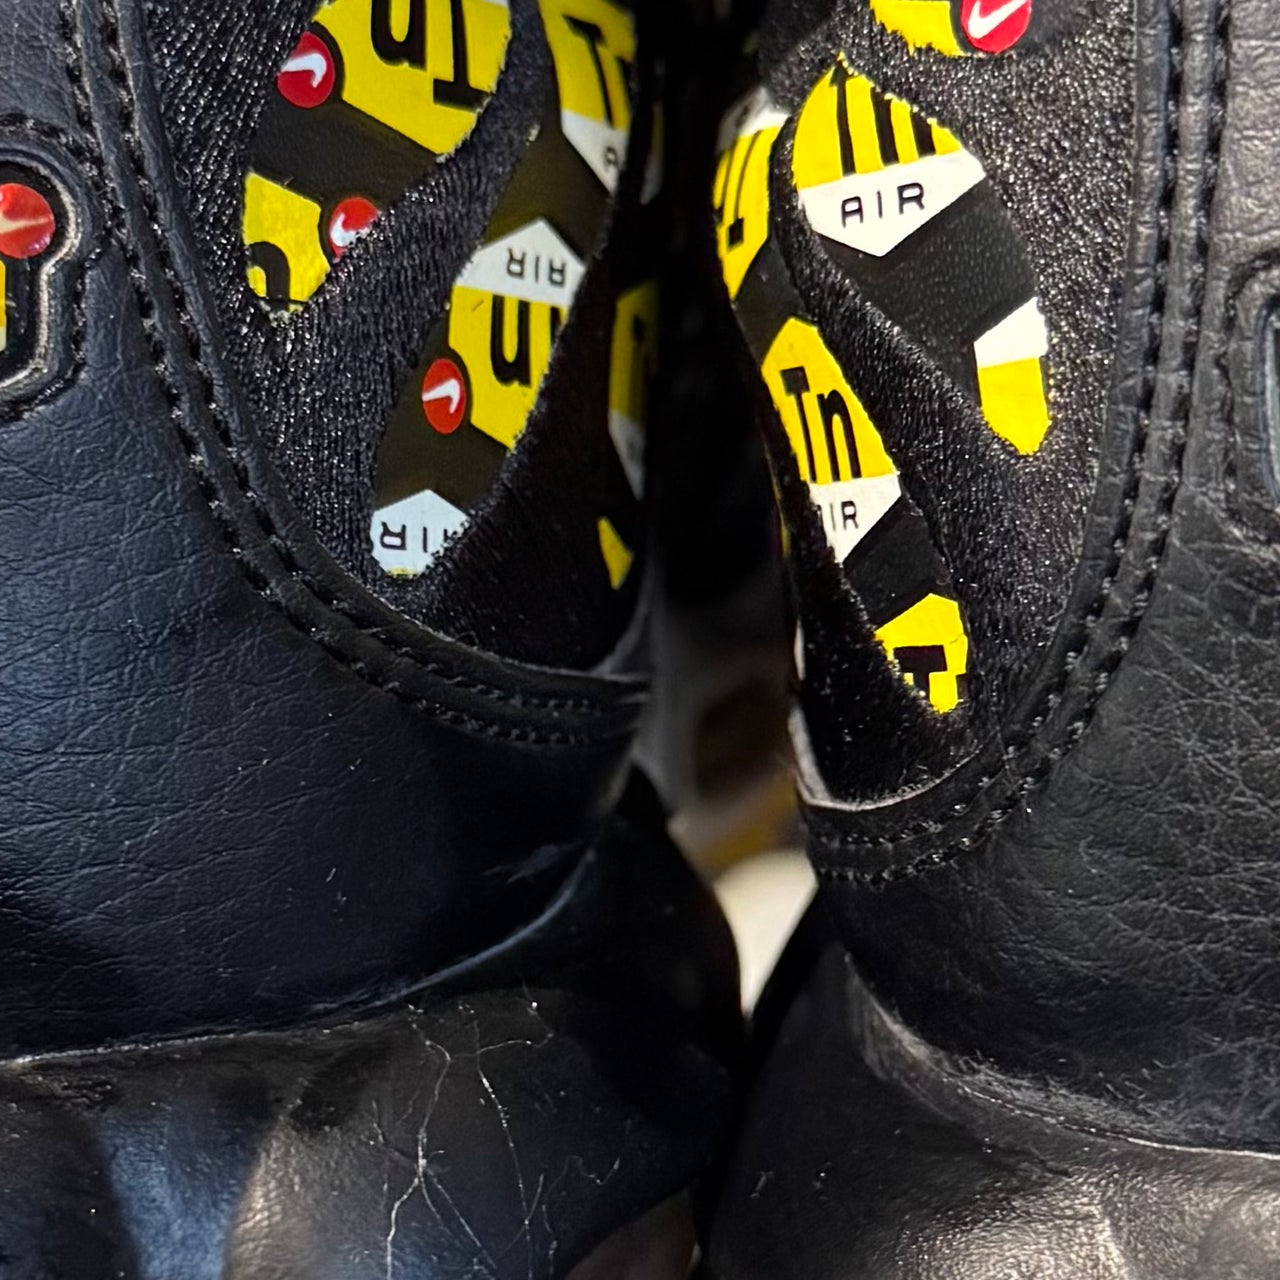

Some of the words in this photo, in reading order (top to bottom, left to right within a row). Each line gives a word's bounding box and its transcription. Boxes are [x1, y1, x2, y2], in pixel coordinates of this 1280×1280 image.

[840, 181, 926, 228] AIR
[506, 247, 567, 289] AIR
[780, 367, 862, 486] Tn
[818, 500, 859, 532] IR
